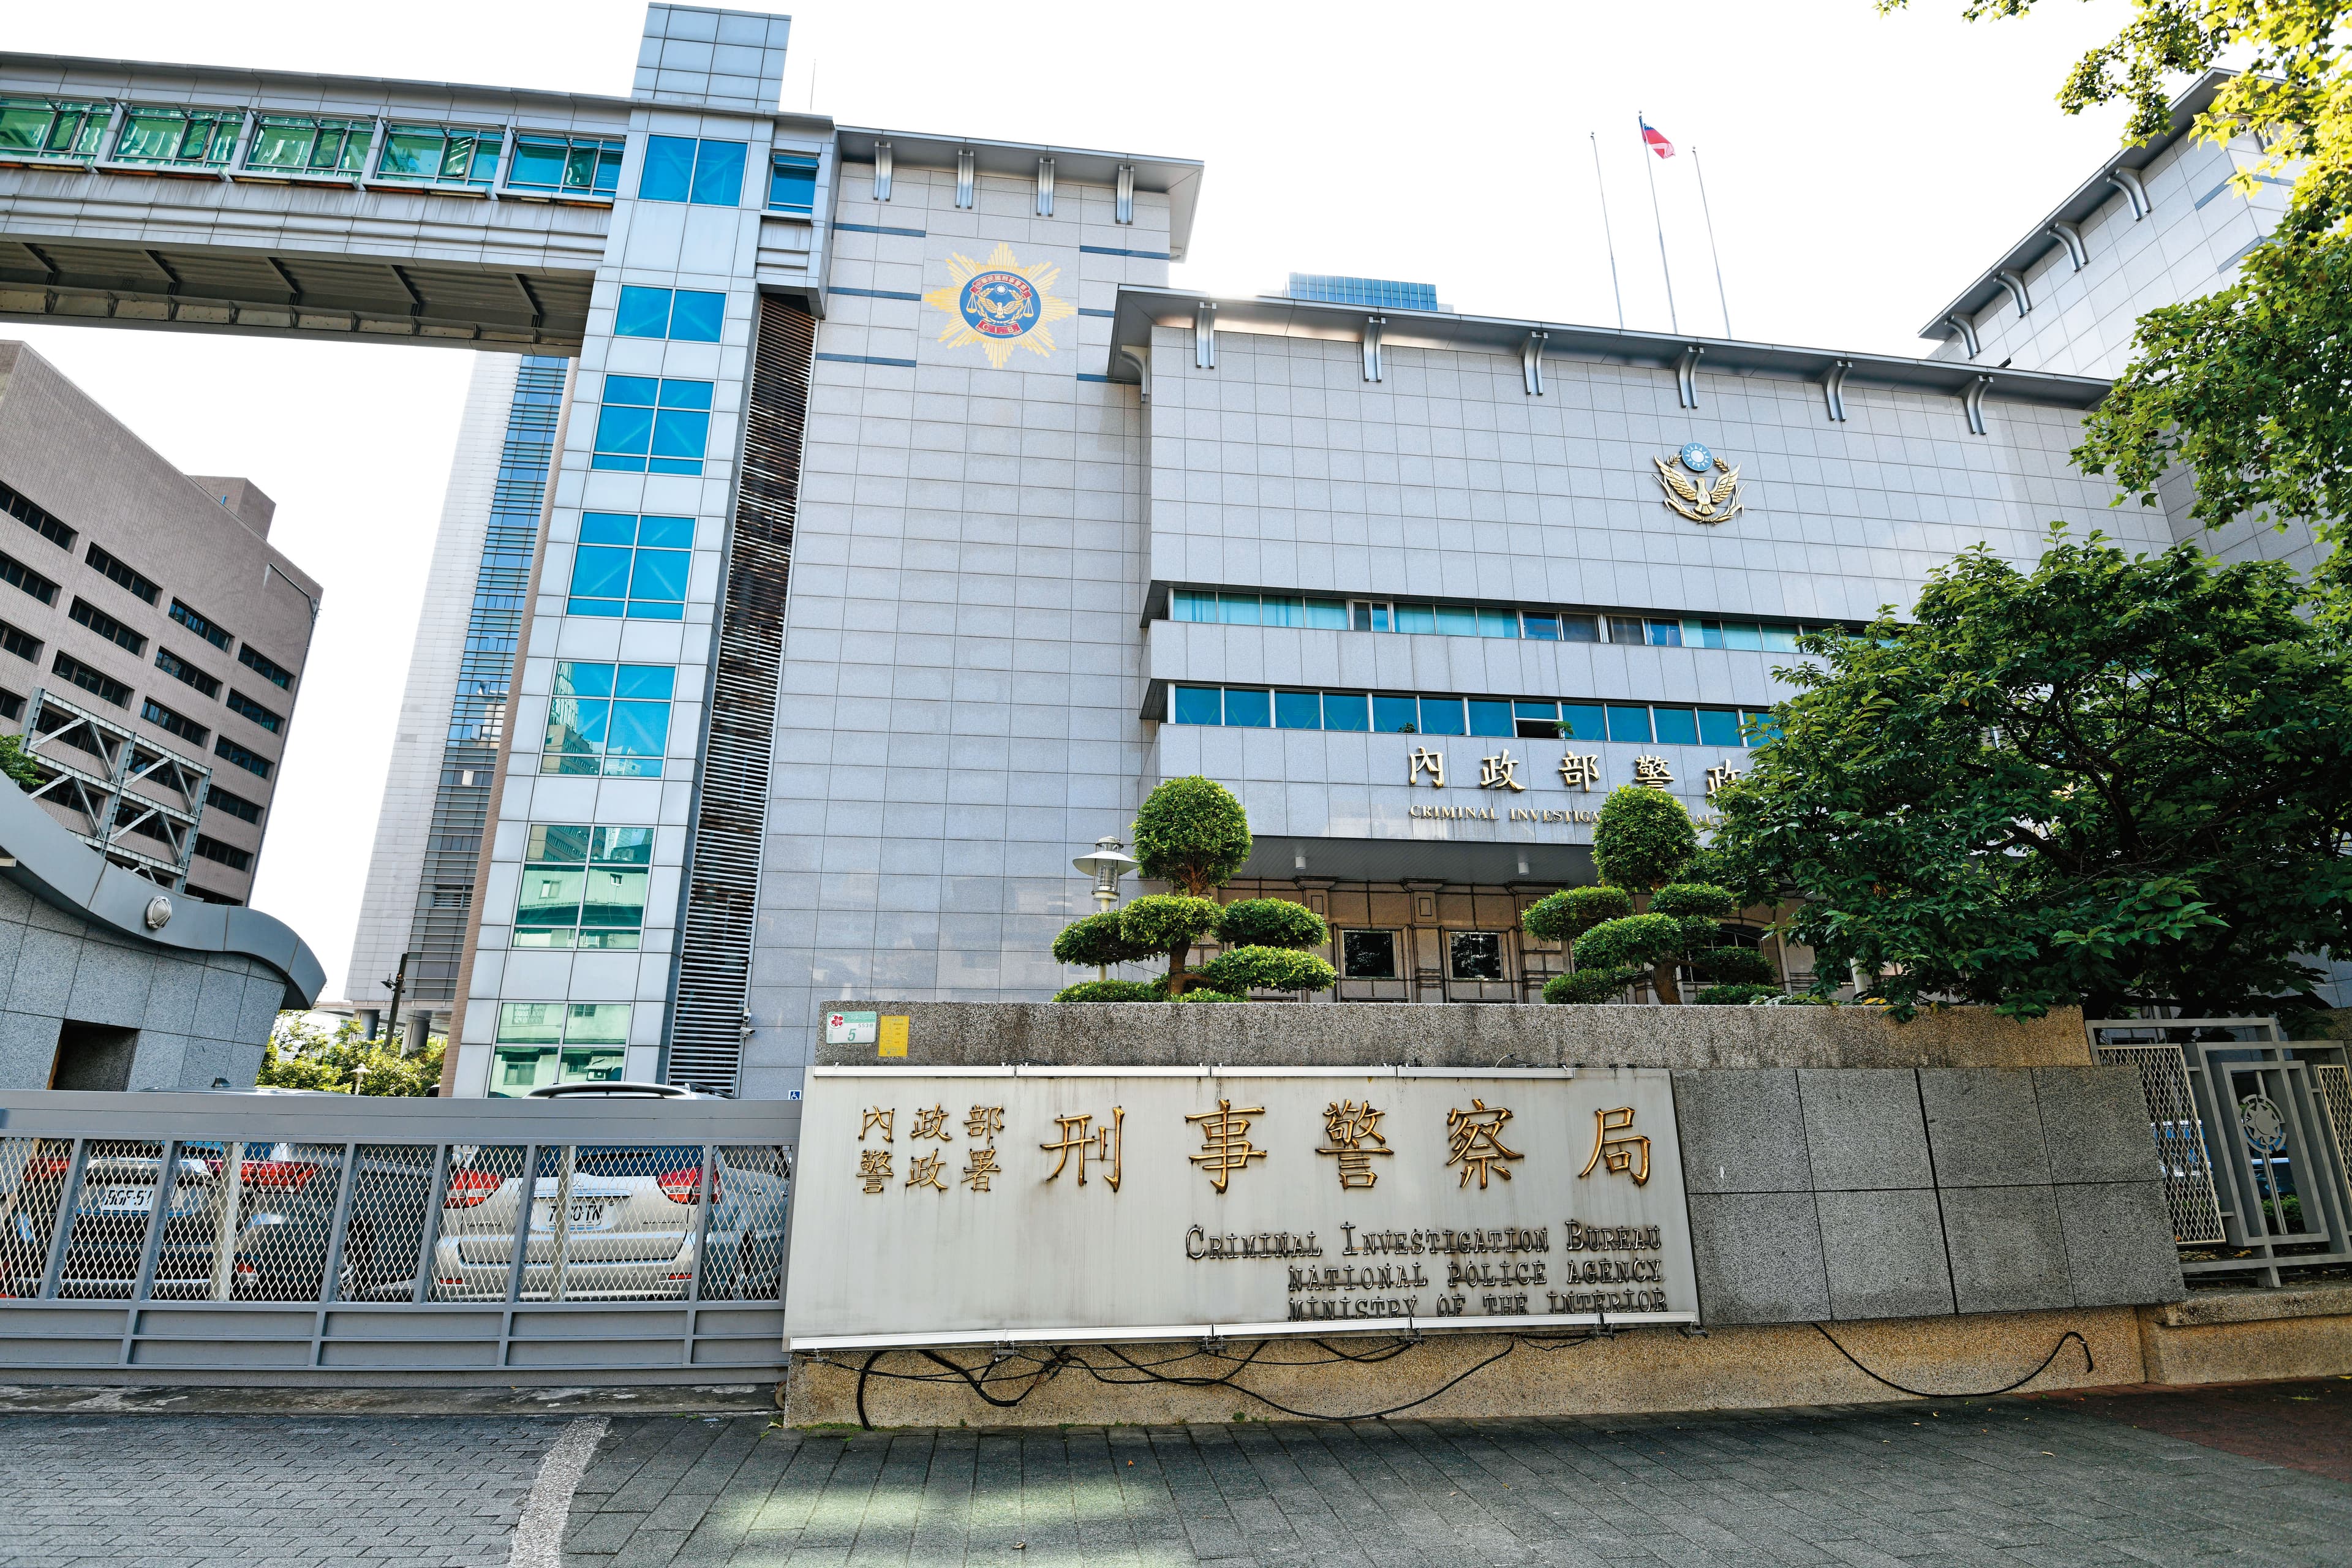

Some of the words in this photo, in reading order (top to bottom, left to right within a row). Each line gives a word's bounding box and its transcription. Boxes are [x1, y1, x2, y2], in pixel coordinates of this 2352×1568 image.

[1409, 805, 1500, 820] CRIMINAL
[1510, 808, 1600, 823] INVESTIGA
[848, 1028, 856, 1041] 5
[858, 1104, 1003, 1144] 內政部
[1040, 1099, 1652, 1194] 刑事警察局
[857, 1149, 1001, 1193] 警政署
[1185, 1224, 1323, 1259] CRIMINAL
[1340, 1223, 1549, 1256] INVESTIGATION
[1565, 1220, 1662, 1251] BUREAU
[1289, 1263, 1428, 1291] NATIONAL
[1447, 1261, 1547, 1288] POLICE
[1567, 1259, 1662, 1284] AGENCY
[1288, 1296, 1418, 1322] MINISTRY
[1436, 1294, 1466, 1317] OF
[1483, 1294, 1529, 1316] THE
[1547, 1289, 1668, 1314] INTERIOR
